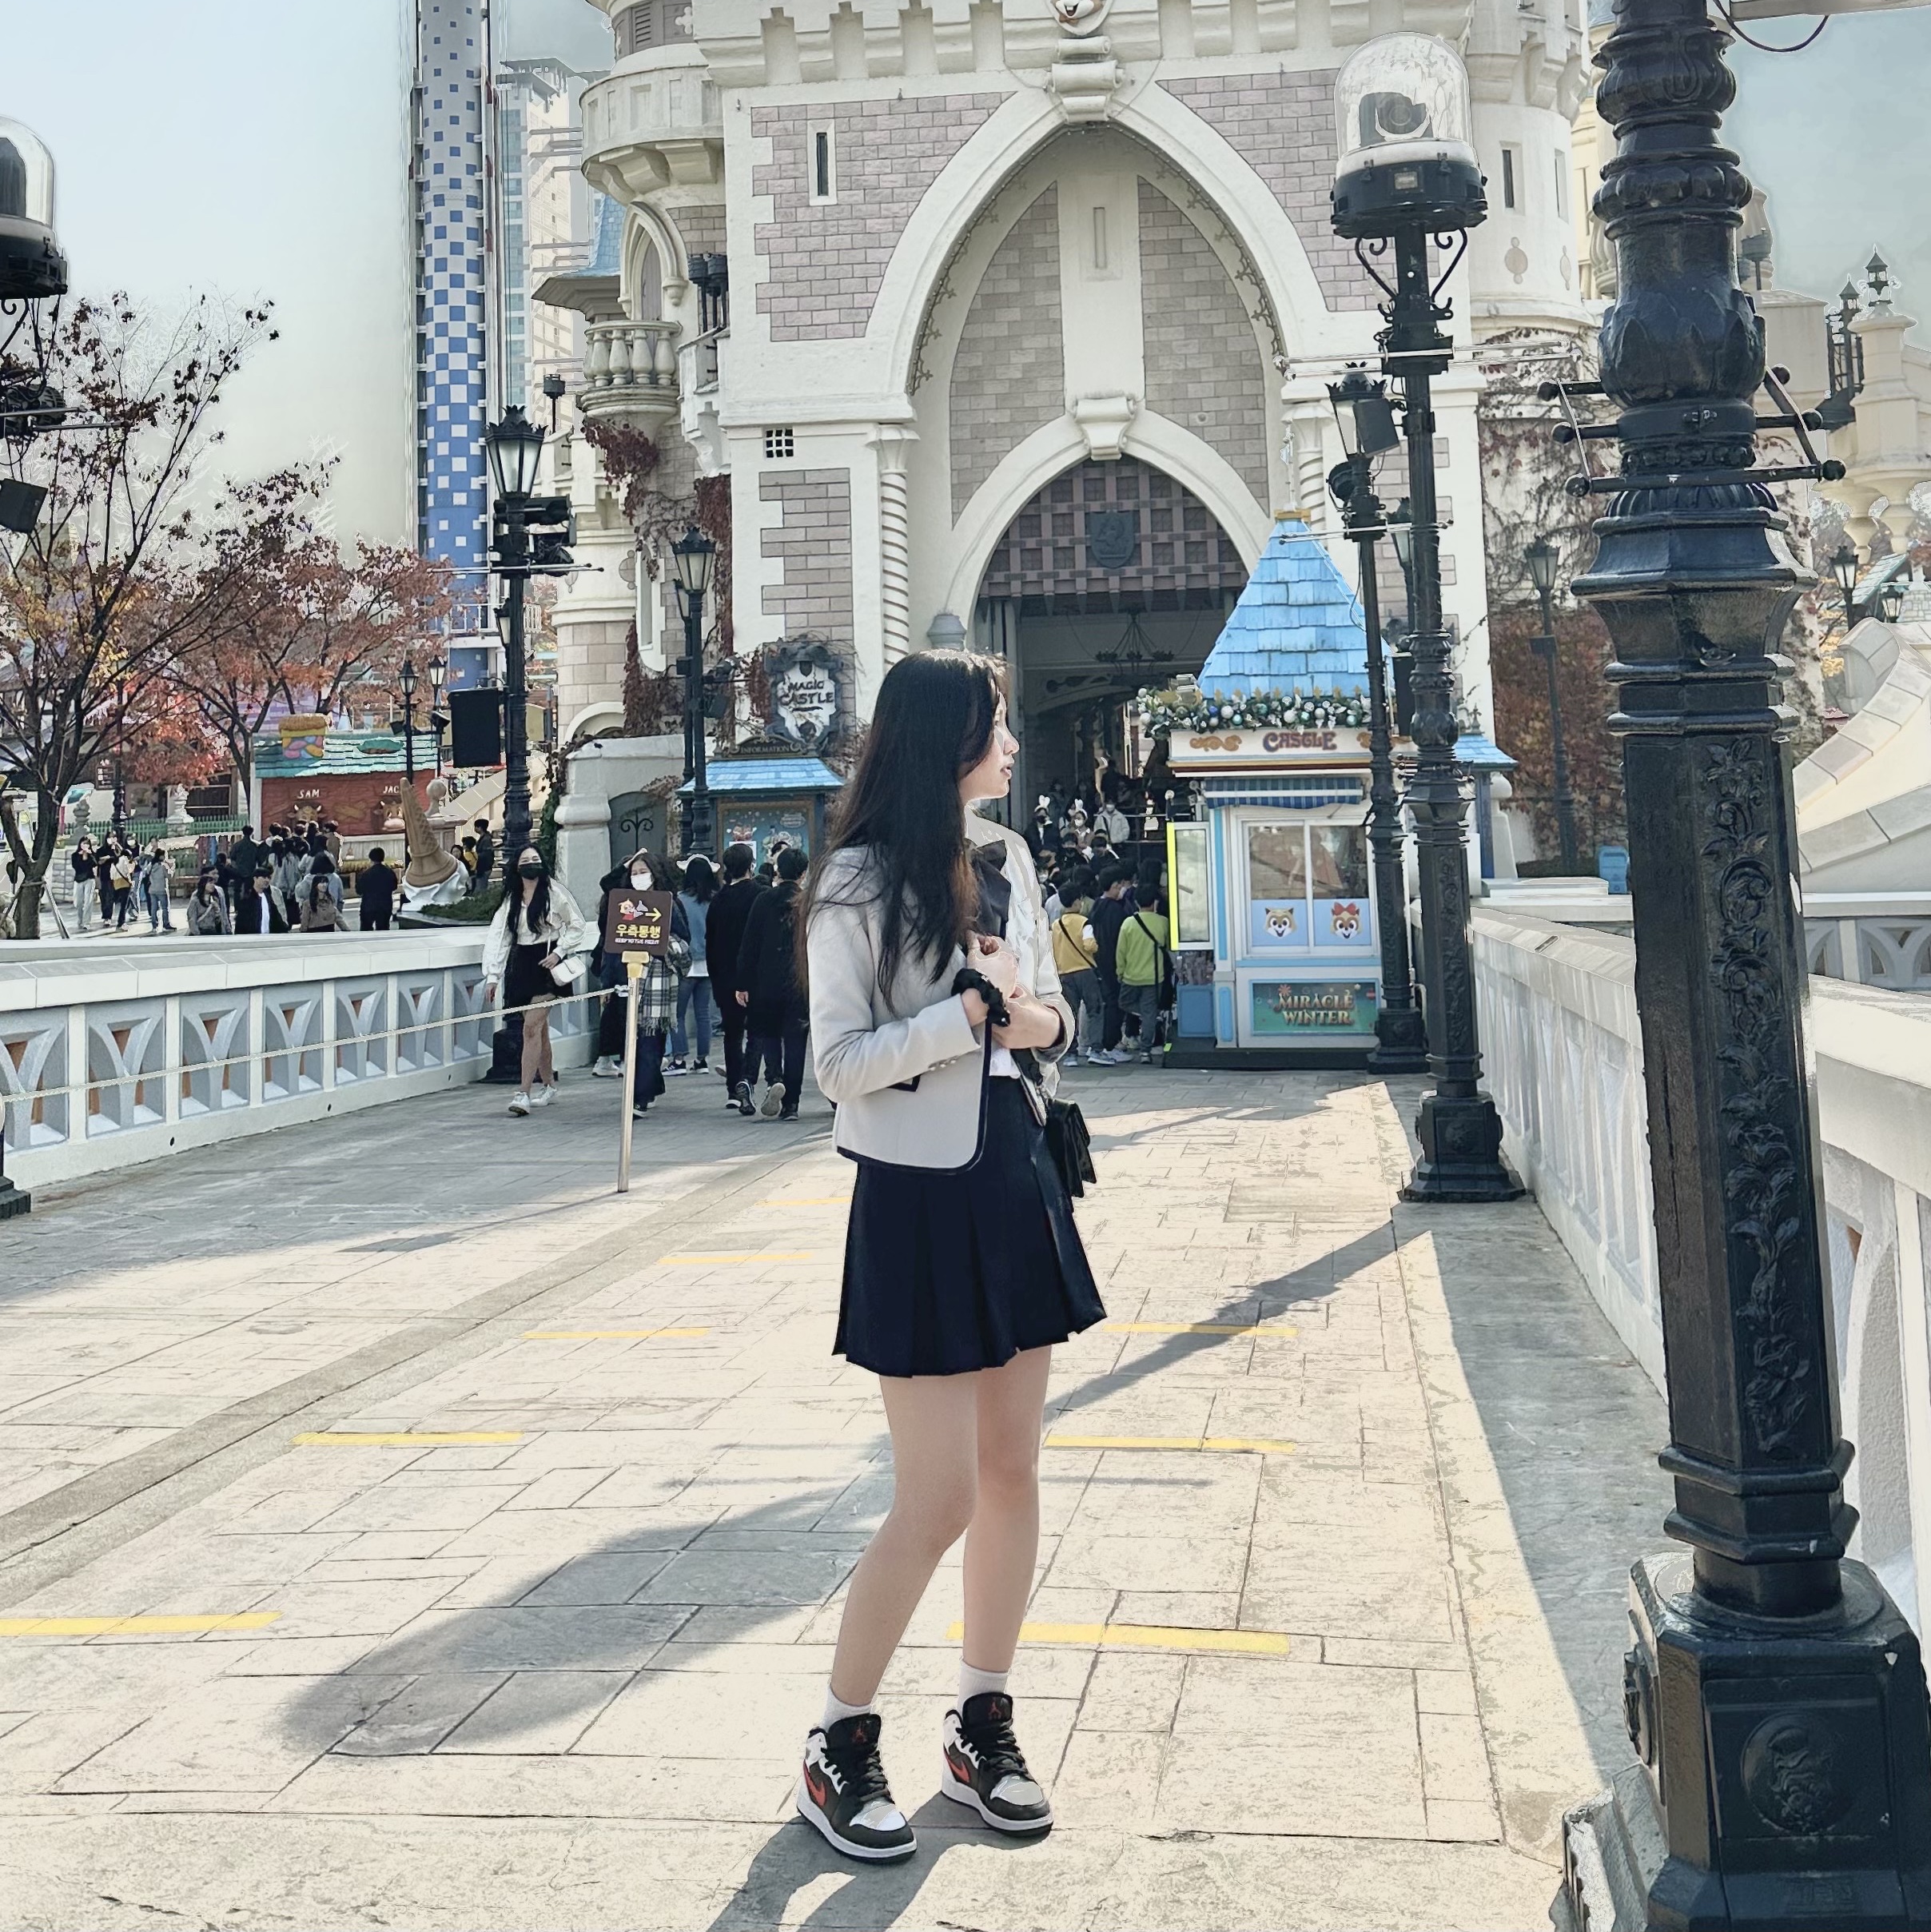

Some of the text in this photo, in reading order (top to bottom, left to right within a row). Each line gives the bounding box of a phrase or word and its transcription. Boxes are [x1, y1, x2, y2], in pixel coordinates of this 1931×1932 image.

[787, 679, 824, 691] MAGIC
[778, 691, 834, 706] CASTLE
[1263, 731, 1337, 752] CASTLE
[740, 745, 790, 754] INFORMATION
[297, 789, 320, 799] SAM
[383, 785, 400, 794] JAC
[615, 924, 661, 938] 우측통행
[1279, 990, 1354, 1009] MIRACLE
[1283, 1010, 1352, 1024] WINTER
